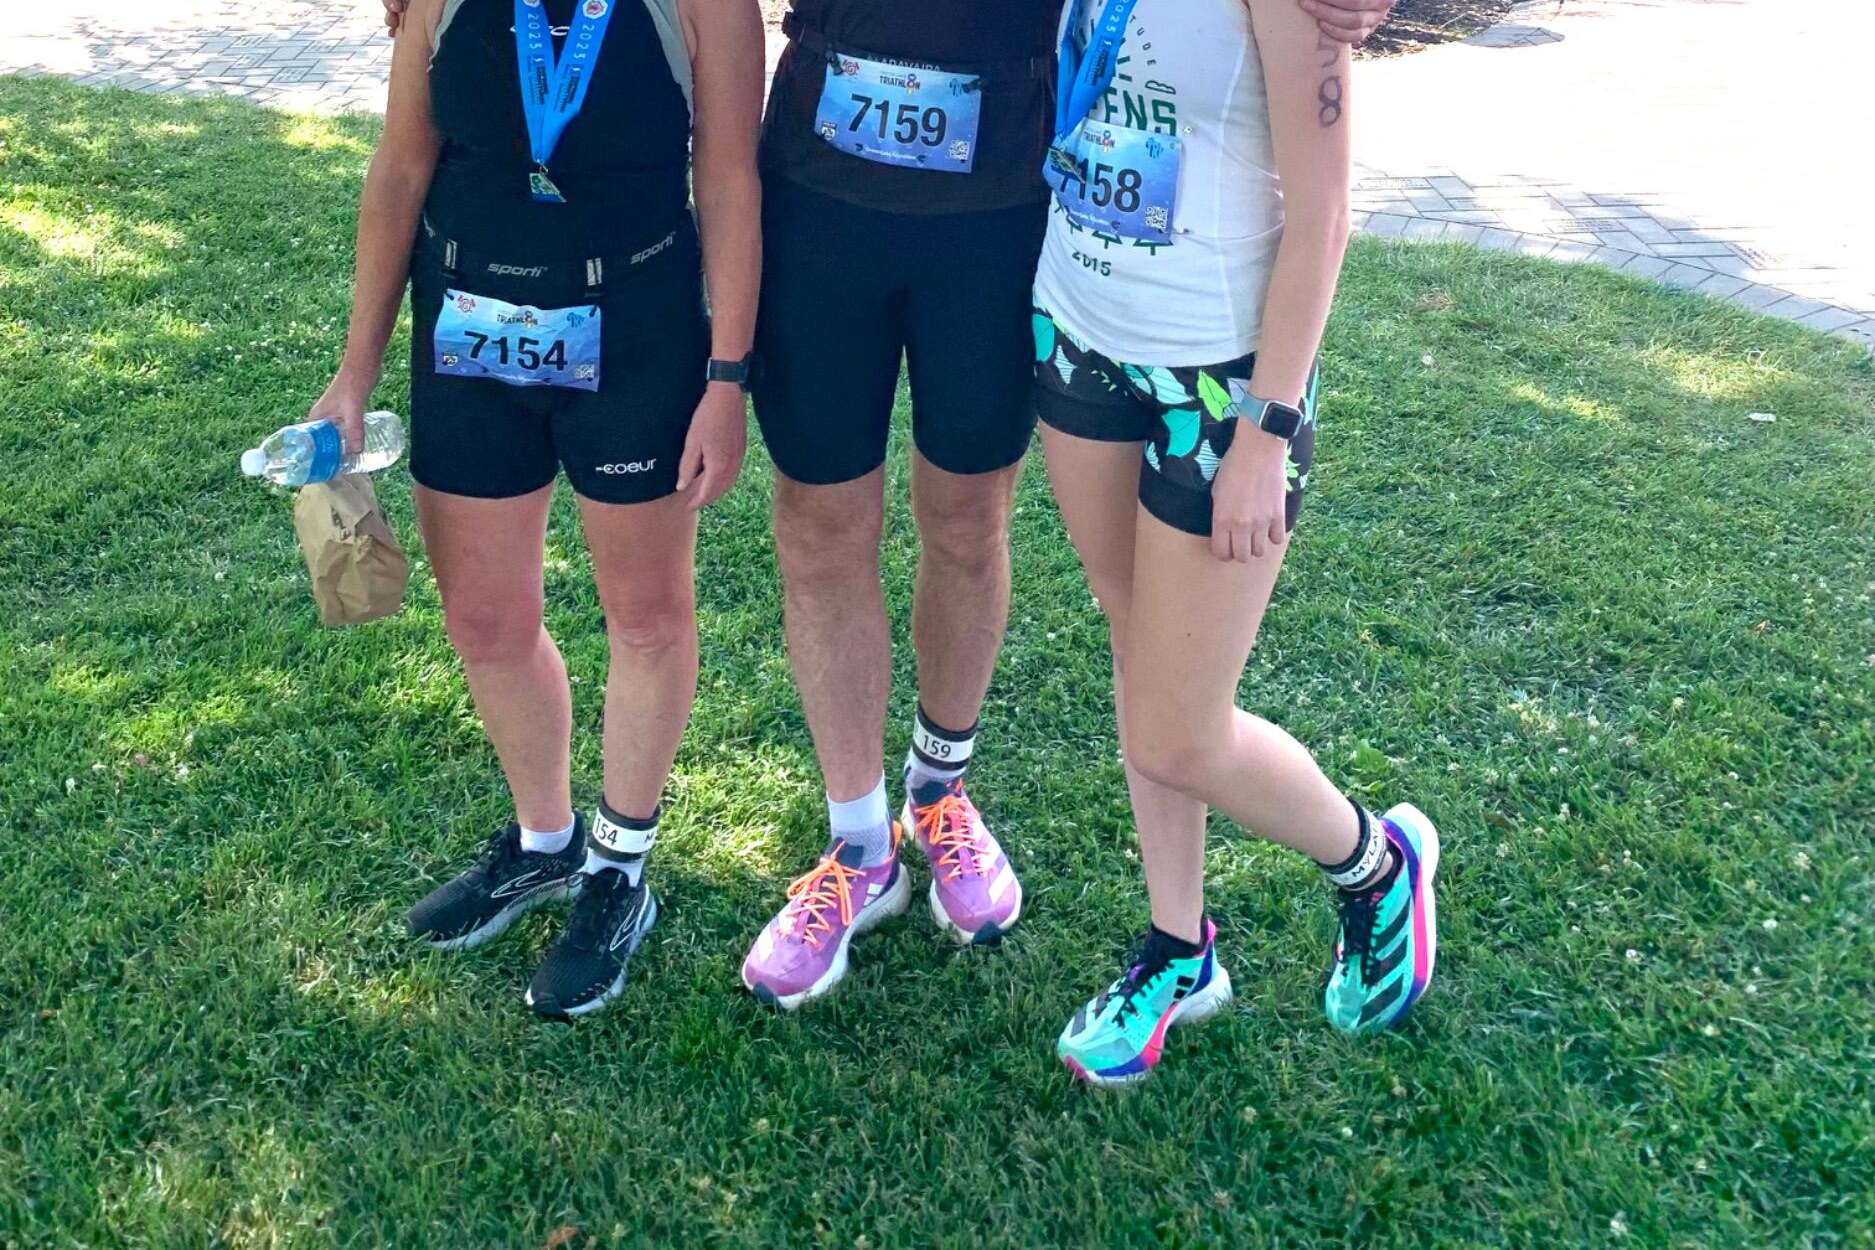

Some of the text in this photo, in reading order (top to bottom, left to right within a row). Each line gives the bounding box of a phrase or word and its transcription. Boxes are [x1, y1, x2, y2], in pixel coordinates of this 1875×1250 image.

[849, 93, 947, 147] 7159
[487, 263, 543, 278] sporti
[1072, 251, 1112, 277] 2015
[464, 330, 568, 371] 7154
[923, 734, 951, 758] 159
